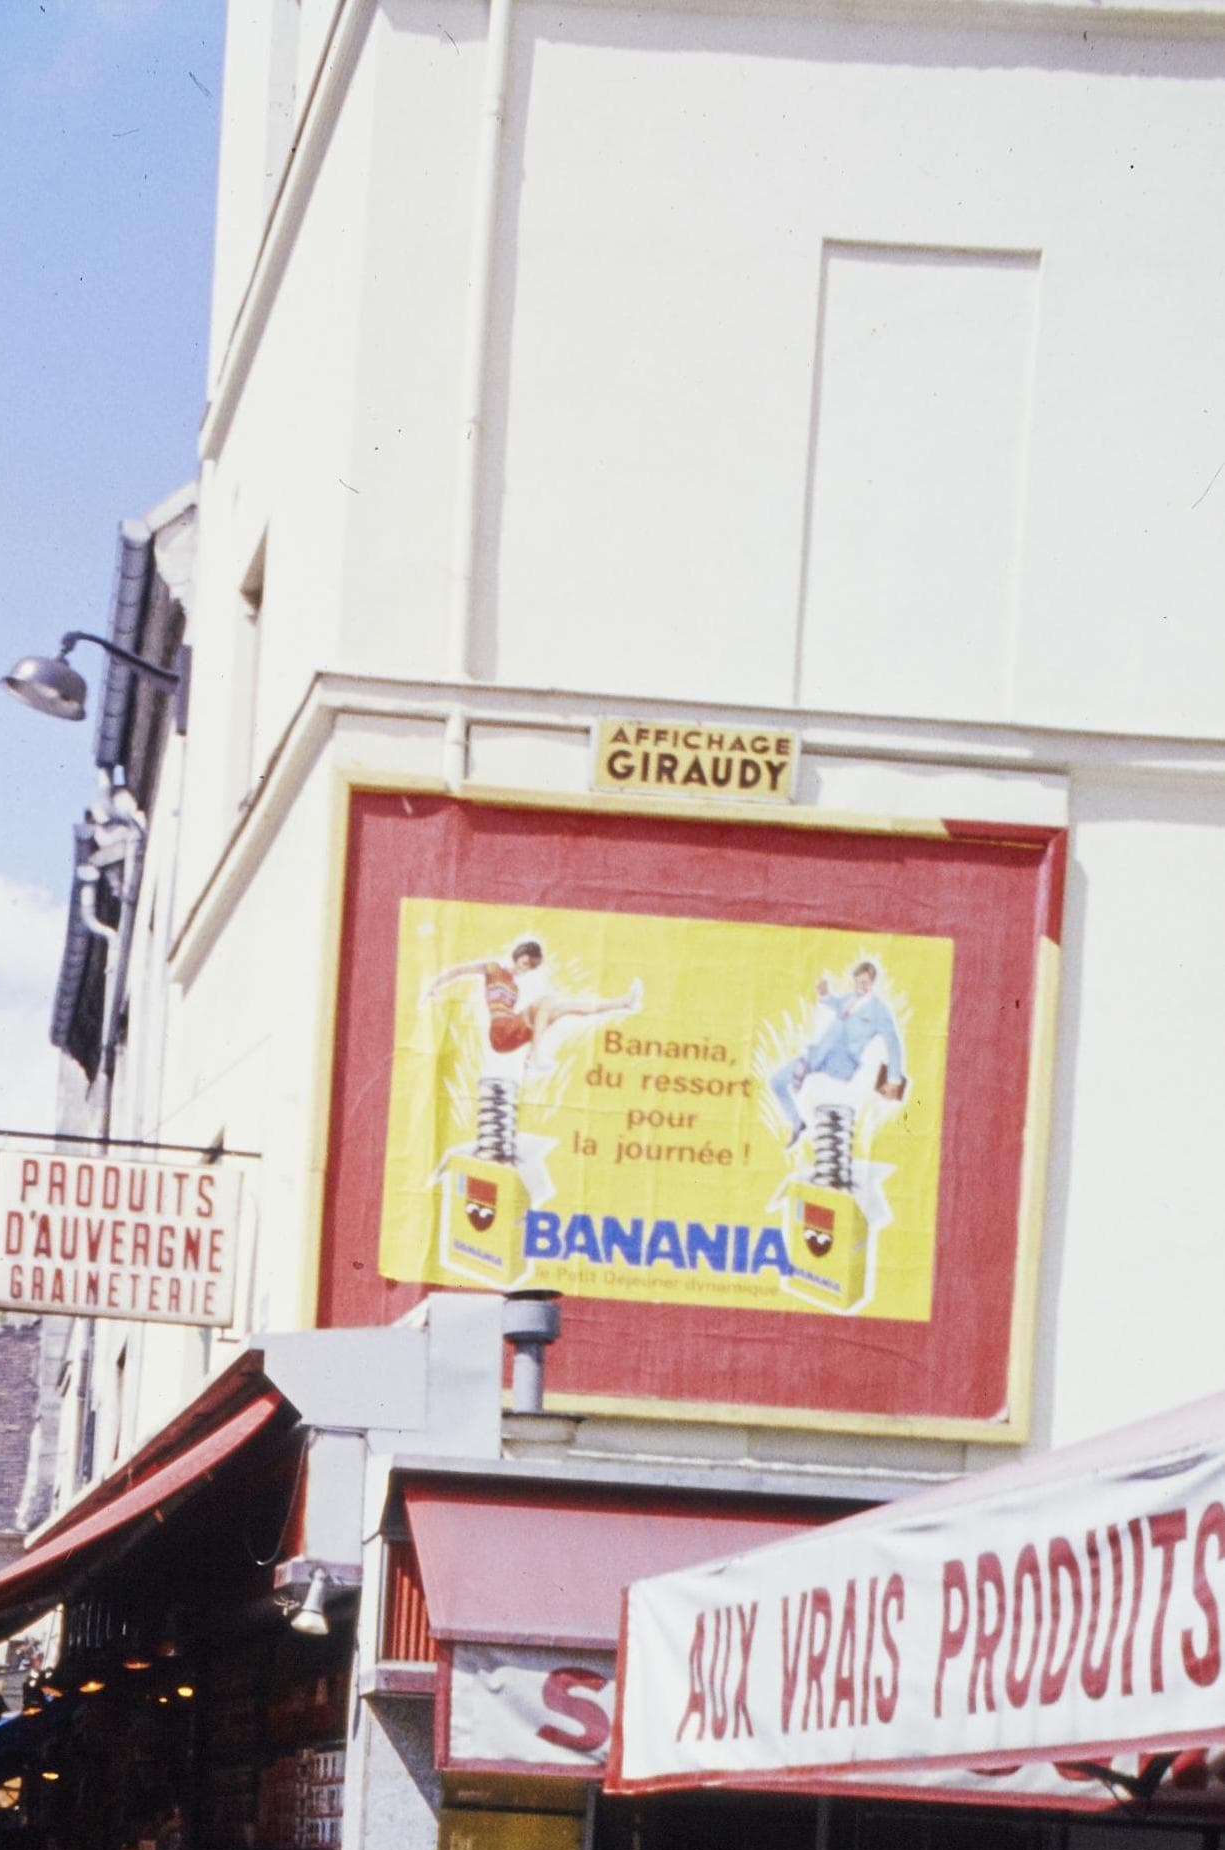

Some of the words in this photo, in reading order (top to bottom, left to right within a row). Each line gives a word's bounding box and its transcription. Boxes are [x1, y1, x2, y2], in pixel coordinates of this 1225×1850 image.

[610, 727, 790, 755] AFFICHAGE
[606, 750, 787, 790] GIRAUDY
[604, 1030, 736, 1066] Banania,
[585, 1064, 623, 1088] du
[641, 1073, 753, 1097] ressort
[627, 1109, 697, 1130] pour
[573, 1131, 597, 1156] la
[21, 1159, 215, 1218] PRODUITS
[5, 1210, 224, 1273] D'AUVERGNE
[523, 1209, 794, 1276] BANANIA
[10, 1264, 217, 1316] GRAINETERIE
[677, 1601, 757, 1743] AUX
[780, 1572, 904, 1735] VRAIS
[934, 1501, 1225, 1718] PRODUITS
